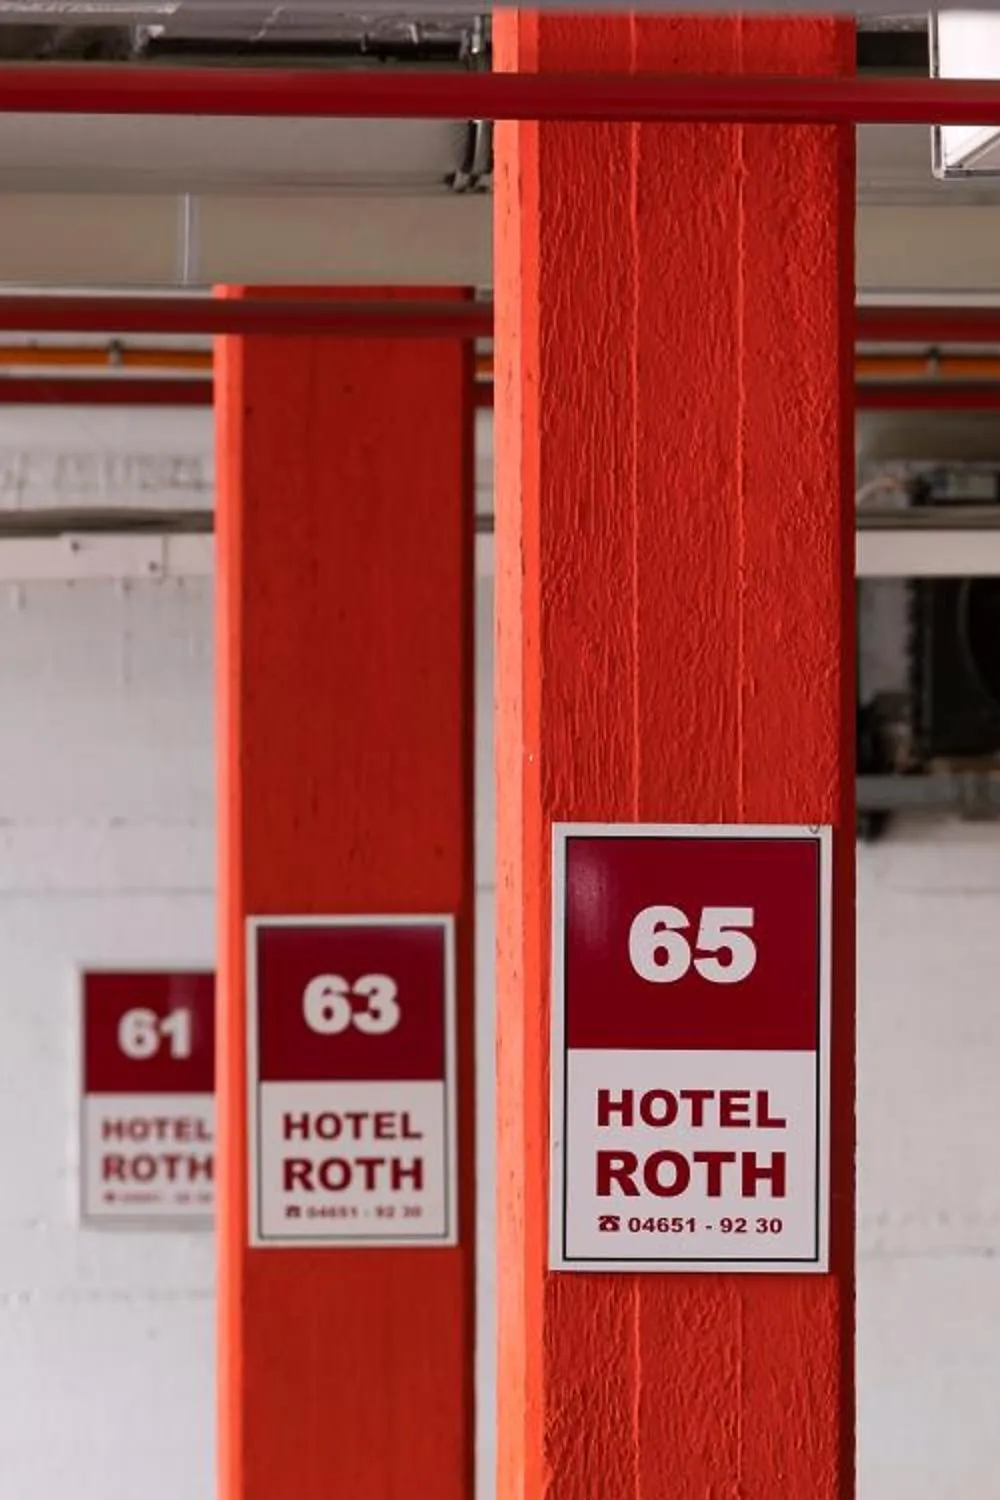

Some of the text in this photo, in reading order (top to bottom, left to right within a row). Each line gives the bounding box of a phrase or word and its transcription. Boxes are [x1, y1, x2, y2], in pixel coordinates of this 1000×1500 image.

[627, 904, 757, 984] 65
[302, 973, 401, 1035] 63
[117, 1007, 193, 1060] 61
[282, 1111, 424, 1141] HOTEL
[596, 1088, 787, 1128] HOTEL
[101, 1116, 213, 1142] HOTEL
[101, 1152, 214, 1182] ROTH
[282, 1157, 424, 1192] ROTH
[595, 1149, 787, 1198] ROTH
[627, 1216, 697, 1234] 04651
[719, 1217, 747, 1234] 92
[755, 1217, 783, 1234] 30
